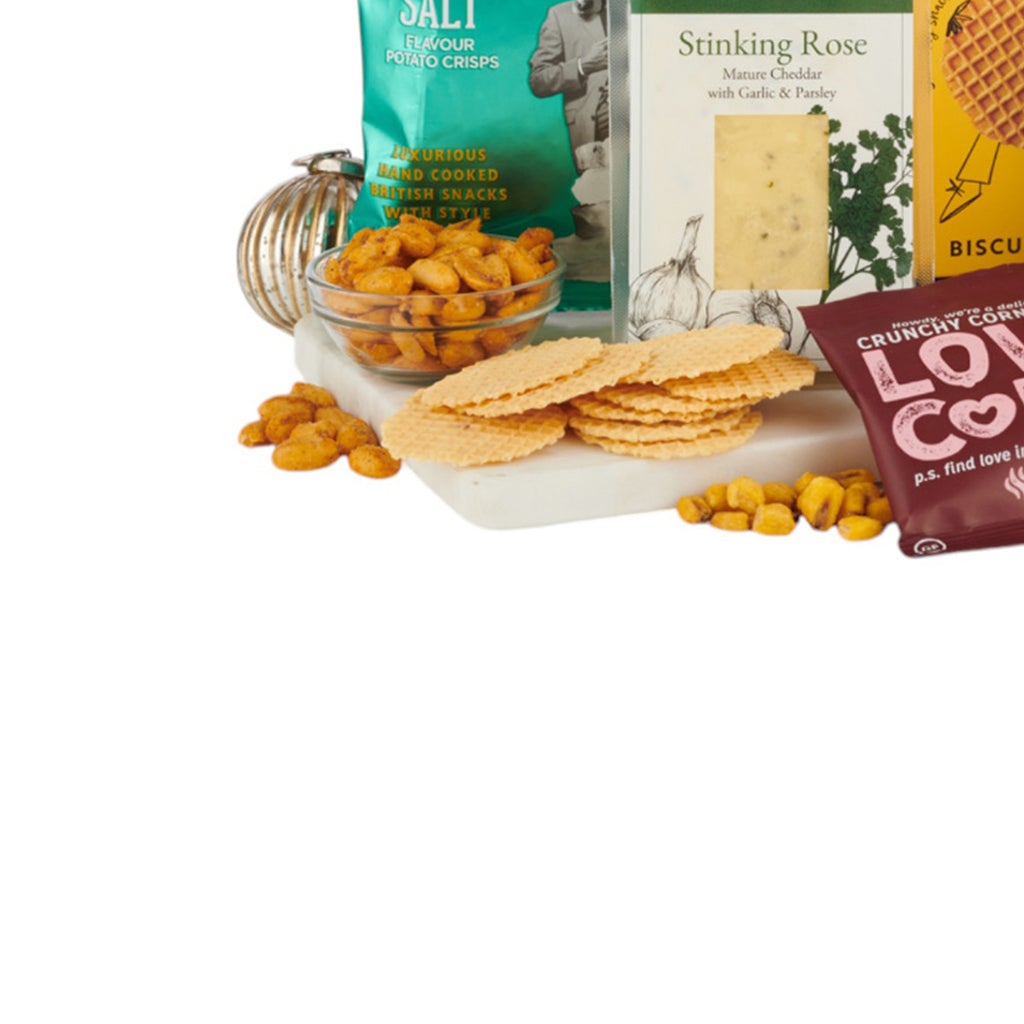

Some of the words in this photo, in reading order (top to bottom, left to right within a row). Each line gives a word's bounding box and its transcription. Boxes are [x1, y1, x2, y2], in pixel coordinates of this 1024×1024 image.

[405, 34, 475, 51] FLAVOUR
[678, 29, 792, 65] Stinking
[801, 31, 867, 56] Rose
[386, 49, 438, 68] POTATO
[442, 55, 500, 69] CRISPS
[722, 67, 767, 81] Mature
[770, 66, 822, 81] Cheddar
[708, 86, 735, 99] with
[738, 85, 776, 99] Garlic
[779, 87, 791, 99] &
[795, 86, 837, 102] Parsley
[391, 144, 487, 162] LUXURIOUS
[378, 162, 424, 181] HAND
[431, 169, 499, 181] COOKED
[370, 182, 434, 200] BRITISH
[442, 188, 508, 200] SNACKS
[892, 316, 942, 330] Howdy,
[944, 306, 980, 319] we're
[856, 317, 961, 350] CRUNCHY
[914, 467, 940, 487] p.s.
[944, 456, 975, 476] find
[980, 449, 1011, 467] love
